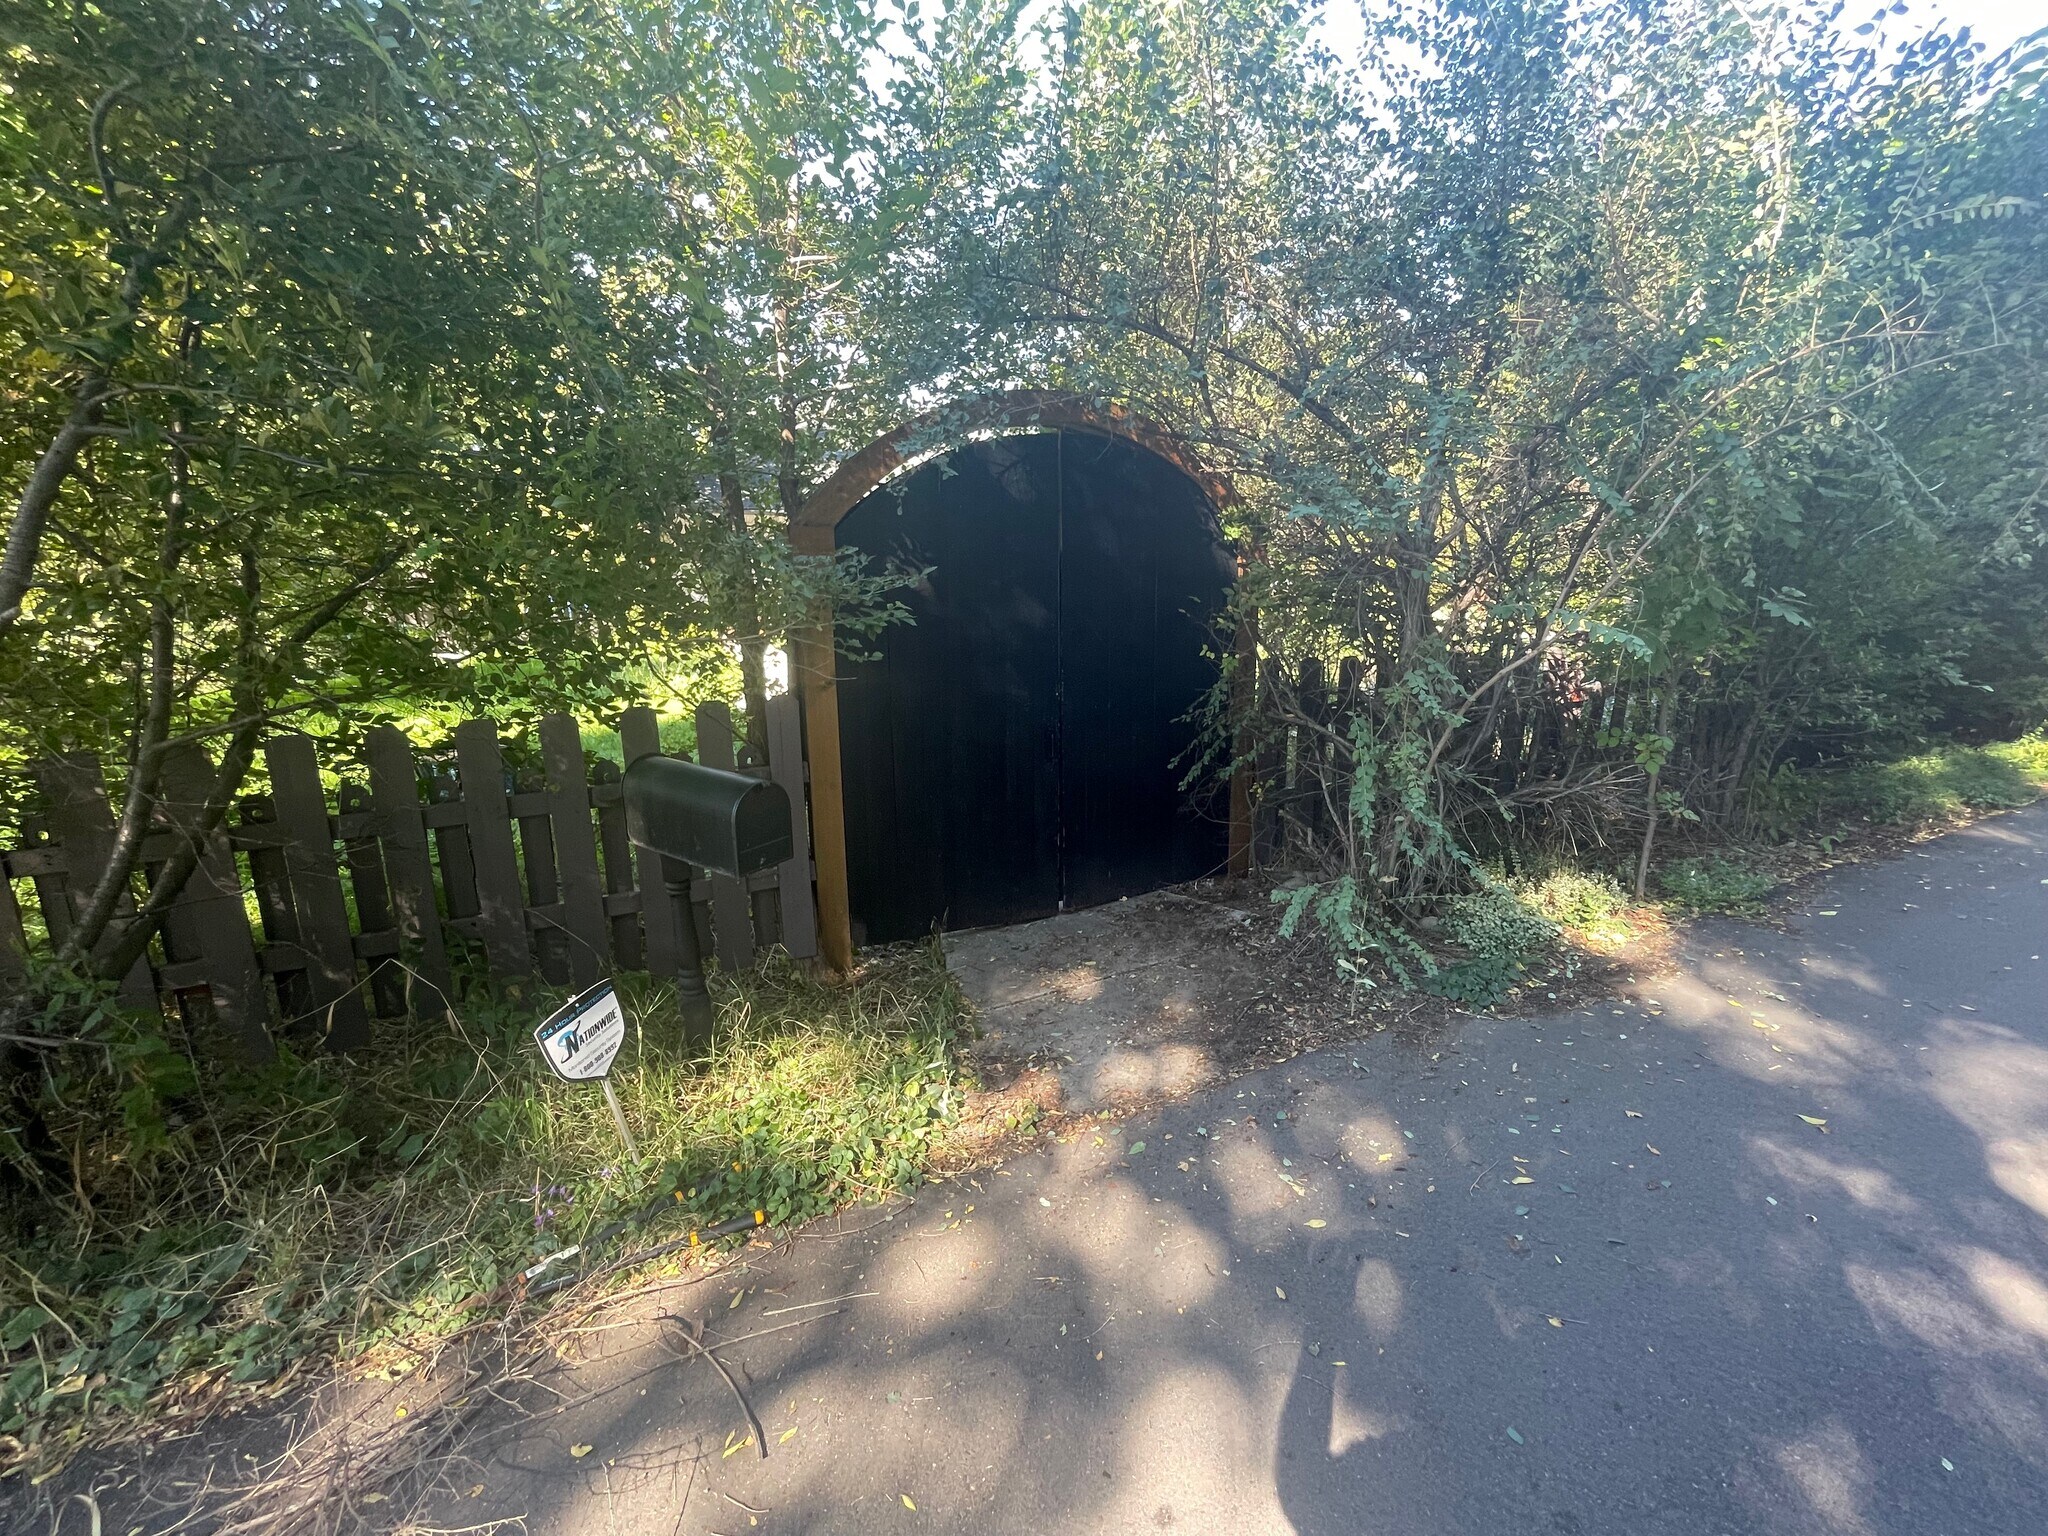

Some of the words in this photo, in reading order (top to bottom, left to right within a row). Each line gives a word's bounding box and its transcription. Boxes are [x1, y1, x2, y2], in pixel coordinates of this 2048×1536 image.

[541, 1029, 553, 1039] 24
[555, 1013, 576, 1030] HOUR
[576, 985, 613, 1014] PROTECTION
[561, 1008, 618, 1064] NATIONWIDE
